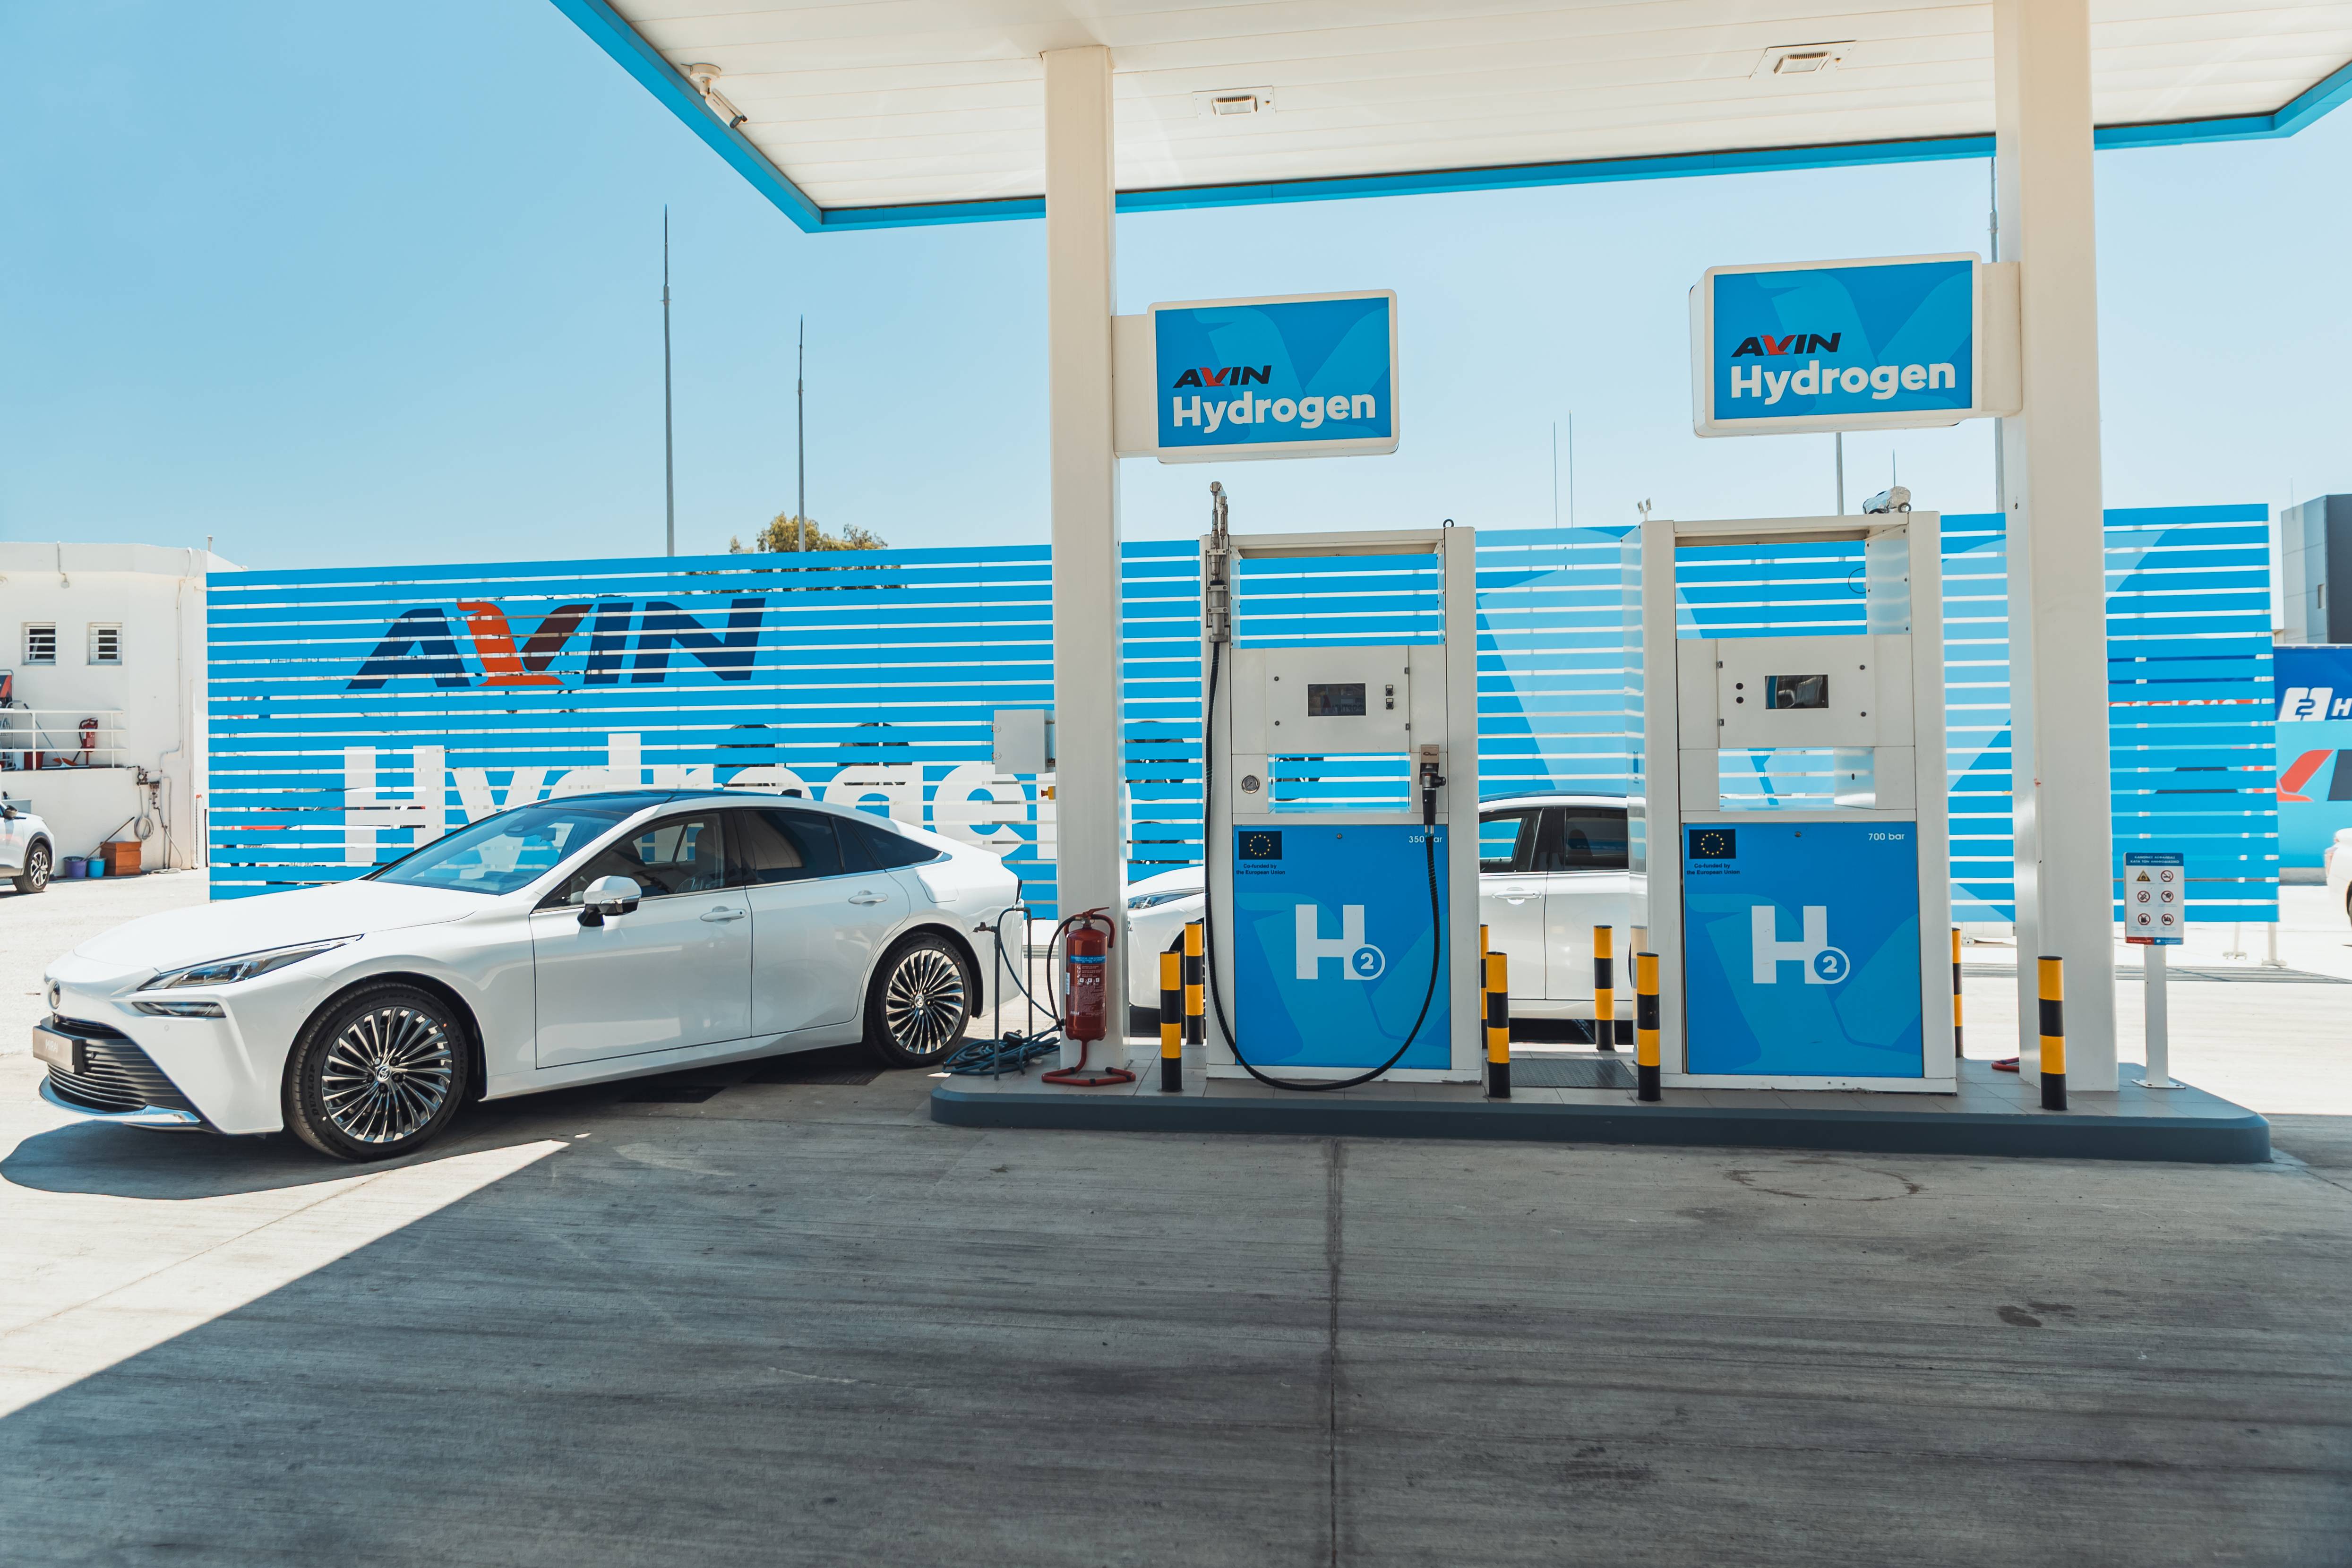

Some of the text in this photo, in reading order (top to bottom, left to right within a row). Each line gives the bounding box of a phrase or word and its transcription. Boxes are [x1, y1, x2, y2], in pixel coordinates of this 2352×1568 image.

[1731, 332, 1841, 358] AVIN
[1173, 365, 1272, 388] AVIN
[1731, 360, 1956, 405] Hydrogen
[1173, 391, 1375, 433] Hydrogen
[346, 598, 766, 689] AVIN
[1409, 835, 1442, 843] 350 ar
[1868, 832, 1905, 840] 700 bar
[455, 1035, 464, 1083] DUNLOP
[308, 1063, 319, 1115] DUNLOP
